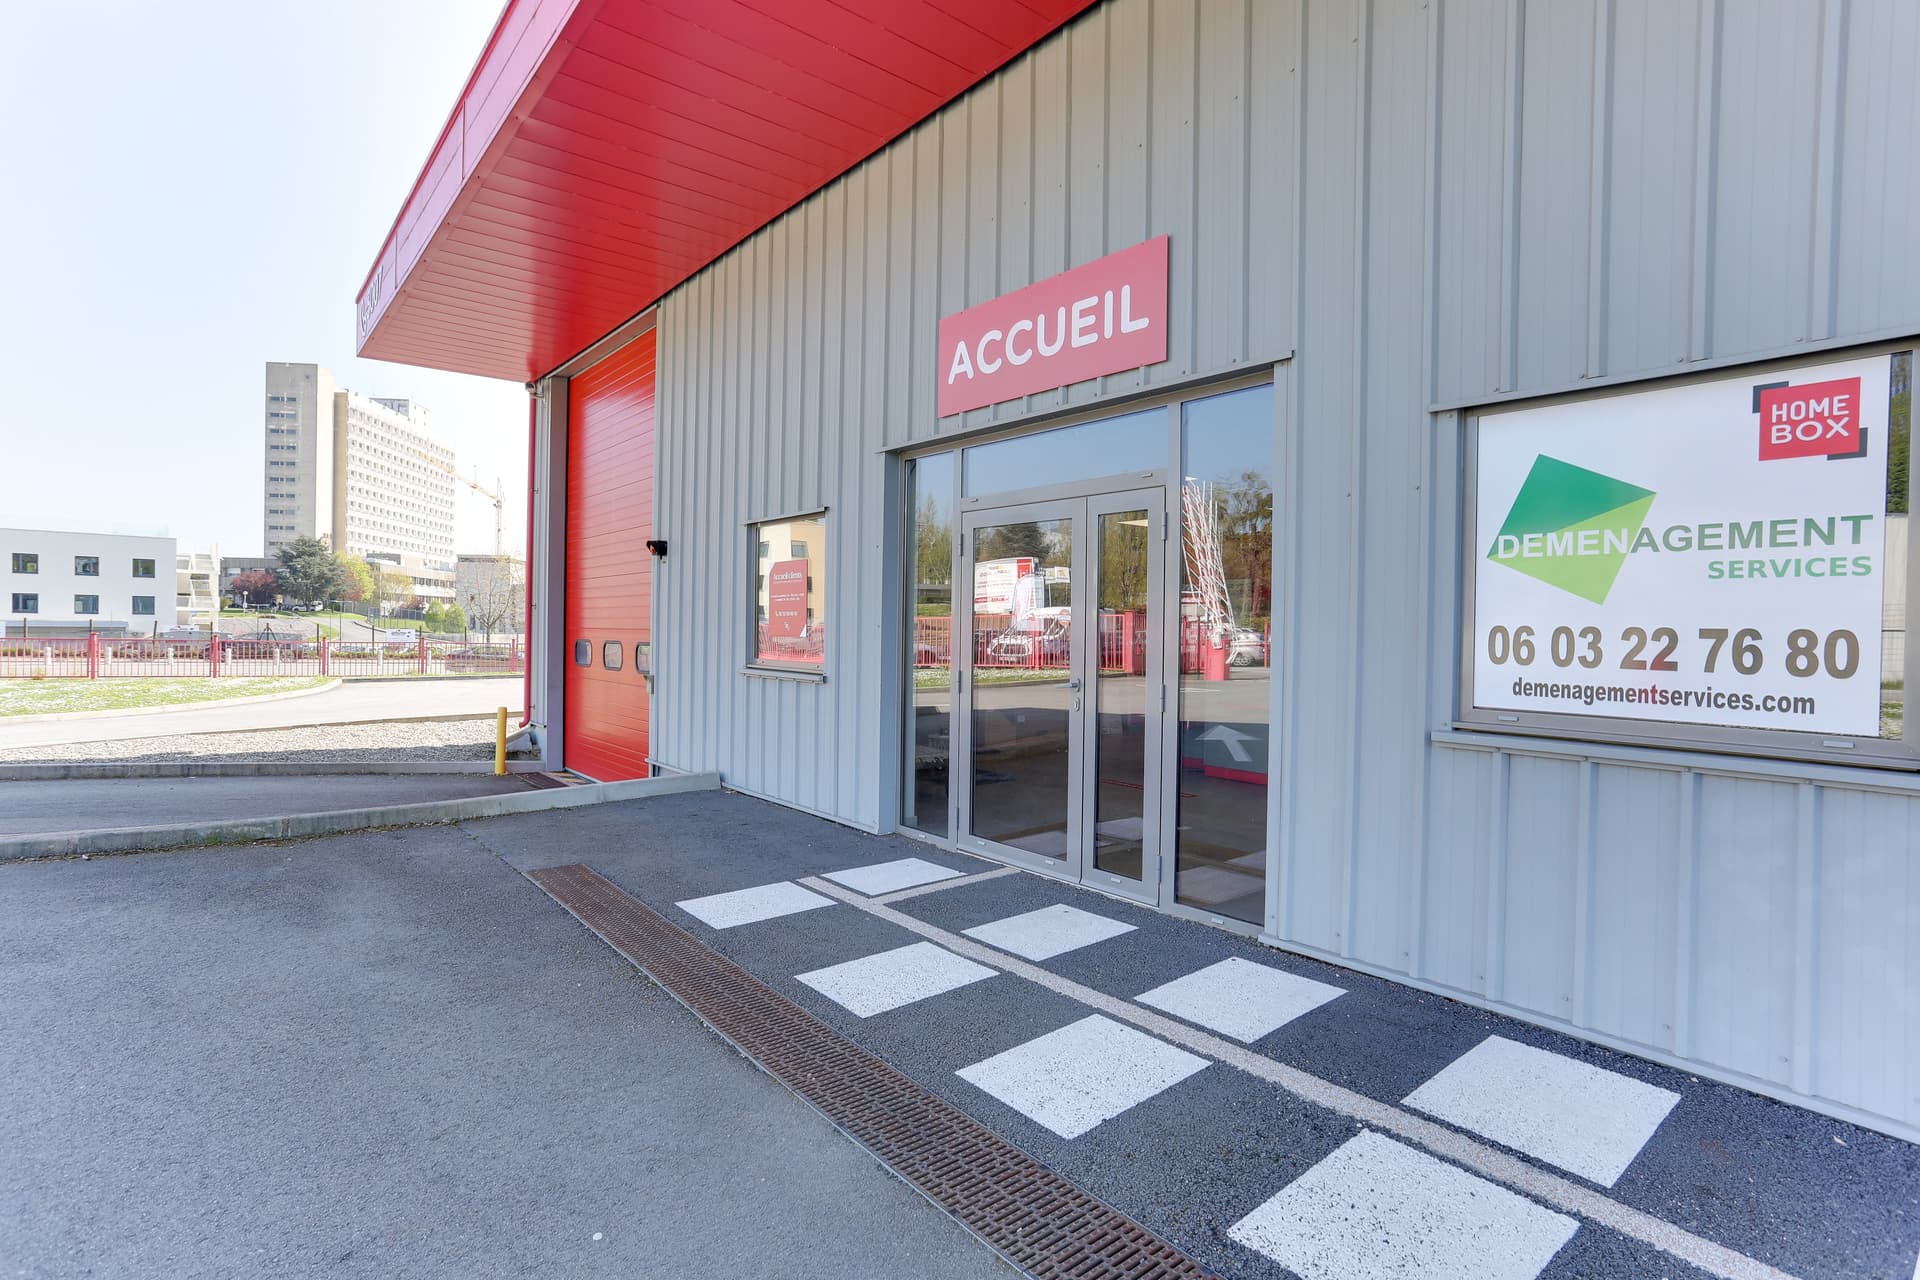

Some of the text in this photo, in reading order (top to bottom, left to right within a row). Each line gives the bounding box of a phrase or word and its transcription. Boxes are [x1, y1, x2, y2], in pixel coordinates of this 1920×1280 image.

[948, 284, 1150, 385] ACCUEIL
[1771, 394, 1851, 424] HOME
[1771, 416, 1850, 445] BOX
[1497, 514, 1874, 559] DEMENAGEMENT
[1707, 555, 1873, 579] SERVICES
[1487, 624, 1860, 680] 06 03 22 76 80
[1512, 676, 1816, 715] demenagementservices.com
